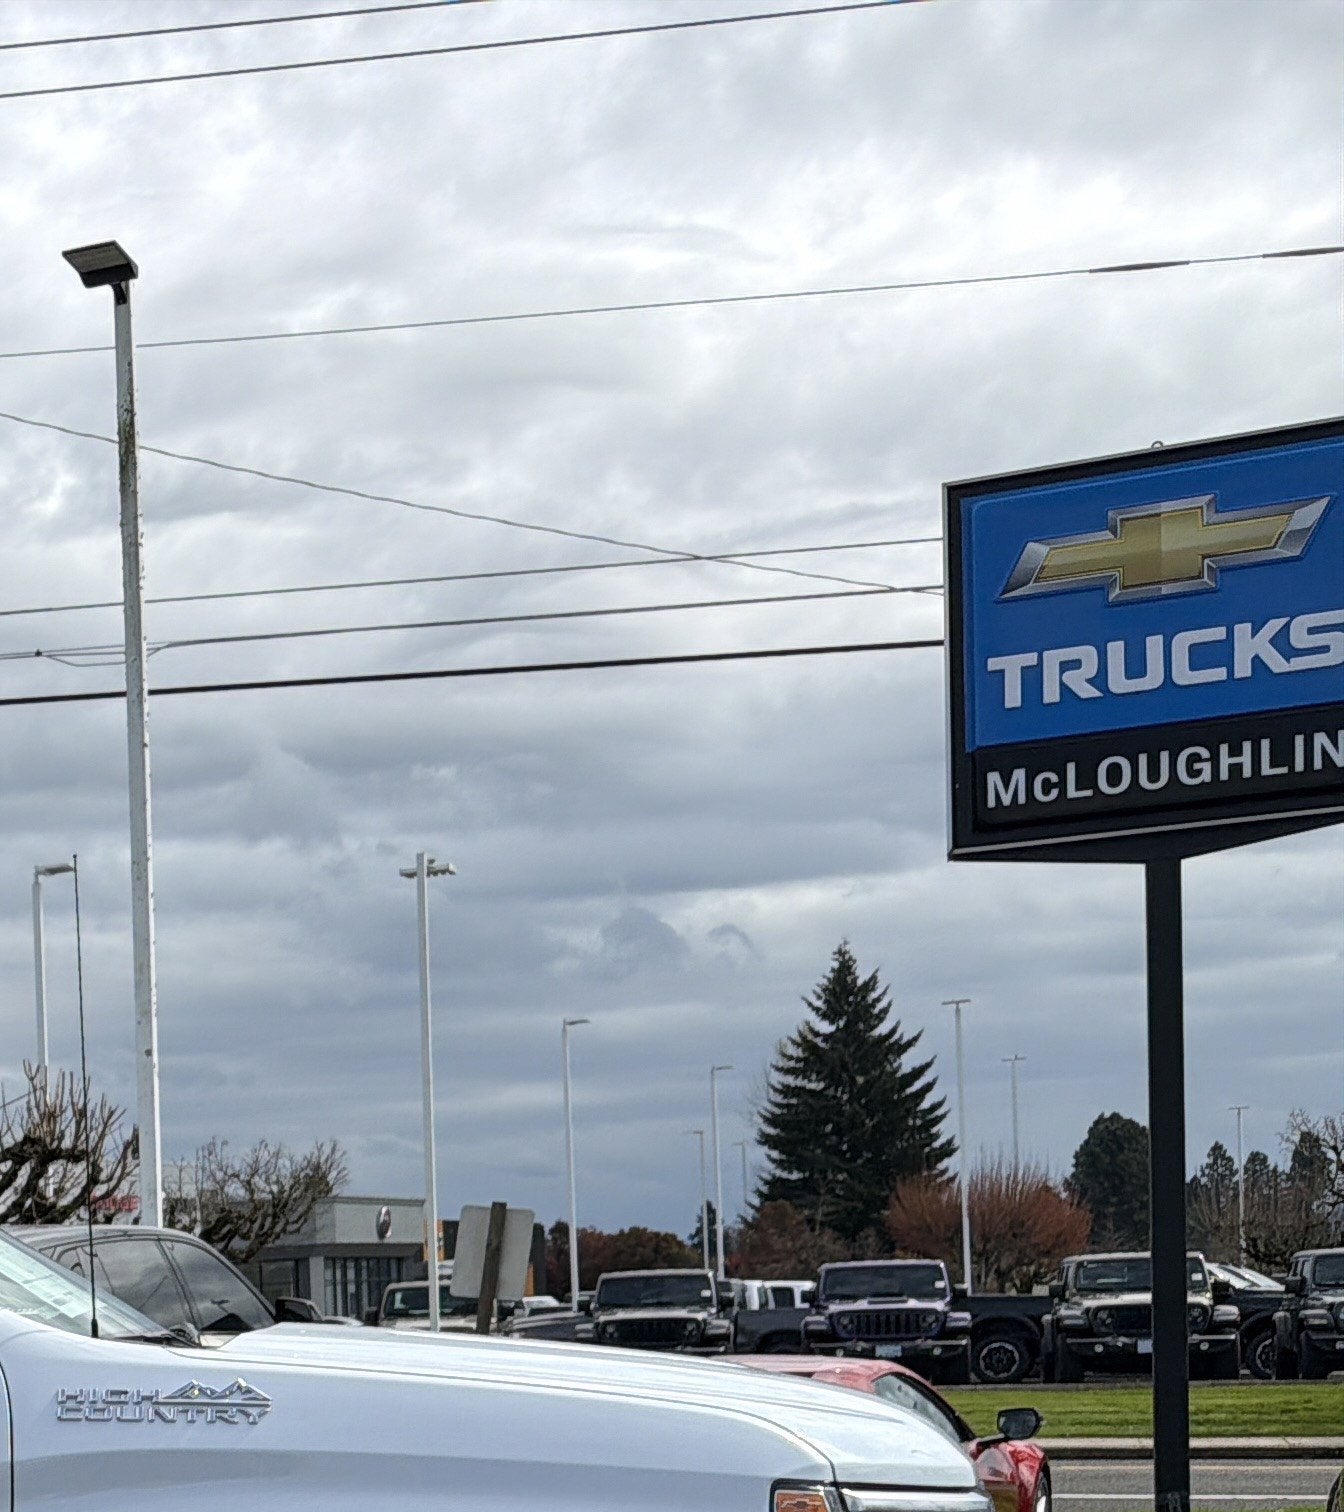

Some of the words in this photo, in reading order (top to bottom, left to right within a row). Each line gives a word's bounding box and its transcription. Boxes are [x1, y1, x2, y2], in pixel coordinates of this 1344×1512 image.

[987, 609, 1344, 709] TRUCKS
[986, 730, 1344, 808] McLOUGHLIN
[57, 1388, 162, 1405] HIGH
[57, 1405, 272, 1425] COUNTRY
